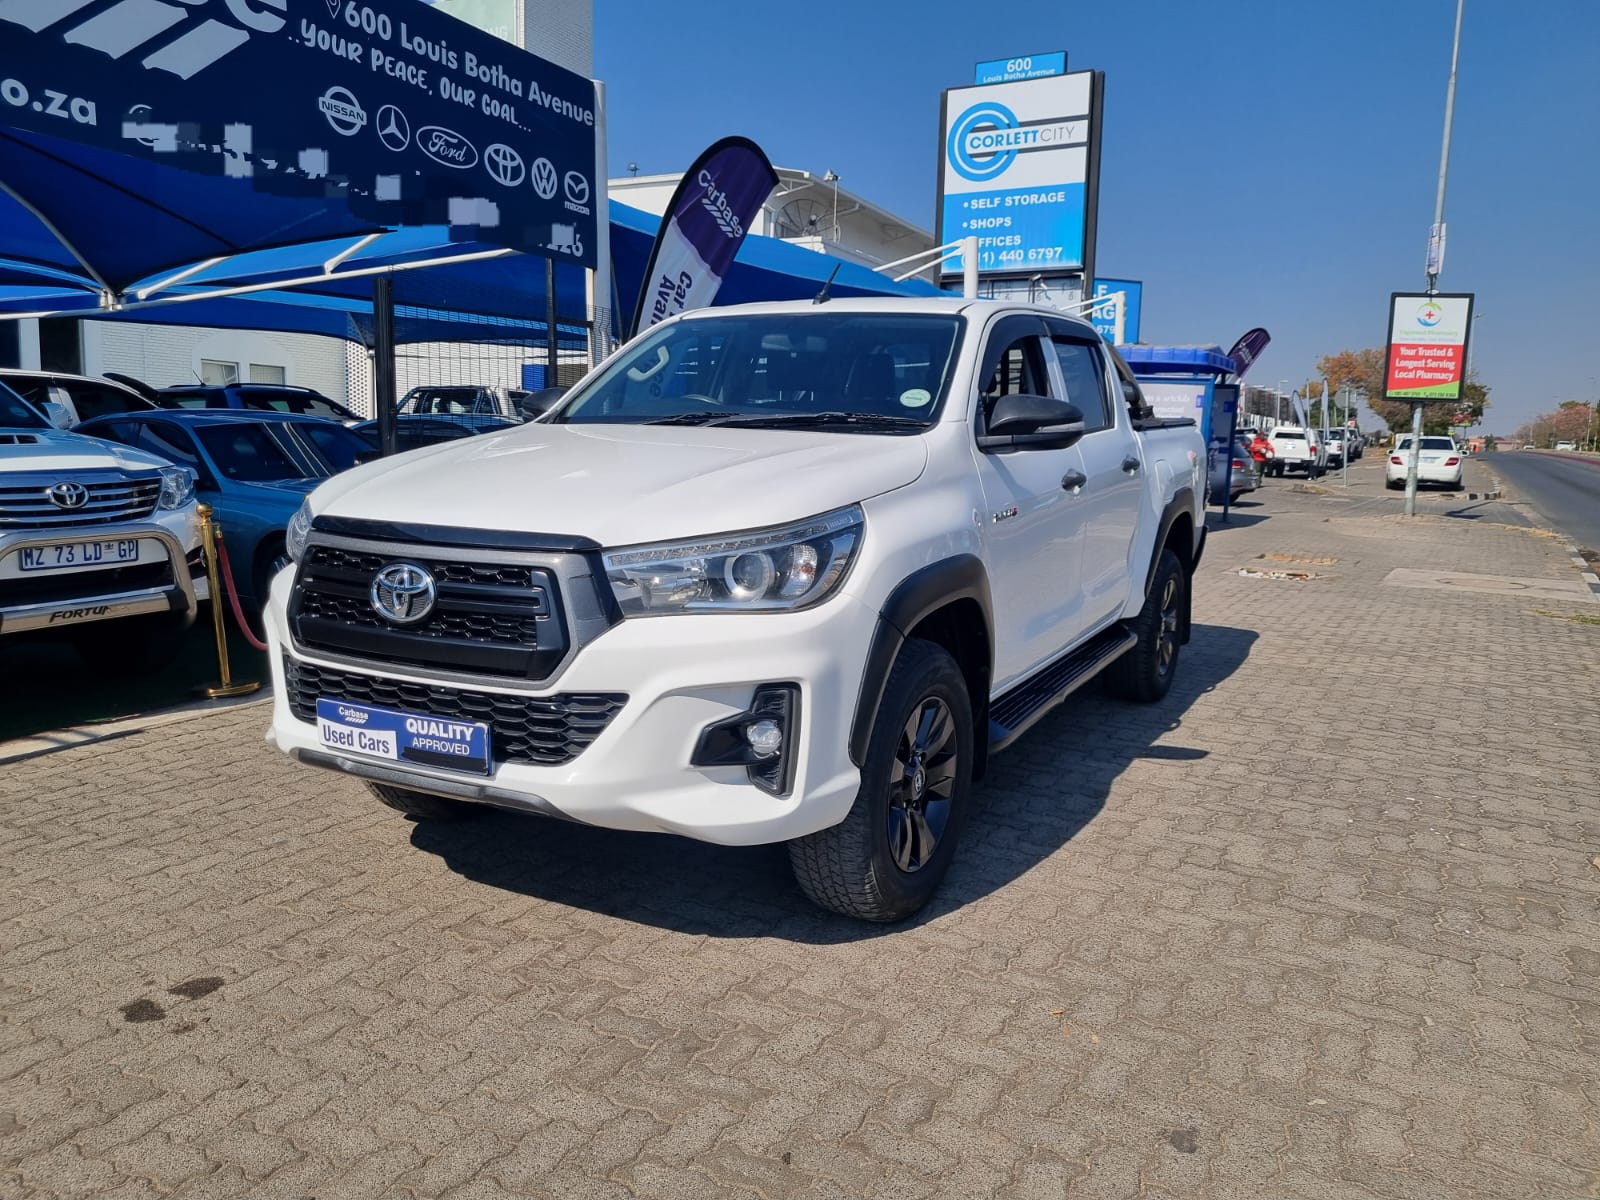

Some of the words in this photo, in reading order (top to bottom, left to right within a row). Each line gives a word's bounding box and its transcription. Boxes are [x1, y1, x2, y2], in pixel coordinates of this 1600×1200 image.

[345, 1, 393, 41] 600
[400, 22, 459, 70] Louis
[464, 51, 524, 97] Botha
[528, 81, 594, 126] Avenue
[1006, 57, 1032, 73] 600
[983, 74, 1002, 83] Louis
[1003, 71, 1025, 81] Botha
[1026, 68, 1056, 78] Avenue
[440, 77, 476, 108] OUR
[321, 100, 365, 123] NISSAN
[428, 131, 467, 163] Ford
[564, 201, 590, 216] mazda
[698, 169, 744, 238] Carbase
[970, 197, 1001, 209] SELF
[1004, 191, 1066, 206] STORAGE
[969, 216, 1012, 229] SHOPS
[978, 235, 1022, 248] FFICES
[998, 249, 1024, 262] 440
[1028, 246, 1063, 261] 6797
[673, 271, 693, 310] Car
[1400, 347, 1417, 356] Your
[1418, 347, 1446, 357] Trusted
[1447, 347, 1454, 357] &
[1395, 358, 1425, 369] Longest
[1426, 359, 1456, 370] Serving
[1394, 370, 1416, 379] Local
[1416, 370, 1454, 382] Pharmacy
[24, 547, 45, 567] MZ
[55, 545, 74, 563] 73
[83, 543, 102, 561] LD
[118, 540, 135, 558] GP
[338, 706, 369, 720] Carbase
[405, 718, 474, 741] QUALITY
[322, 724, 355, 747] Used
[358, 731, 390, 754] Cars
[412, 737, 470, 755] APPROVED
